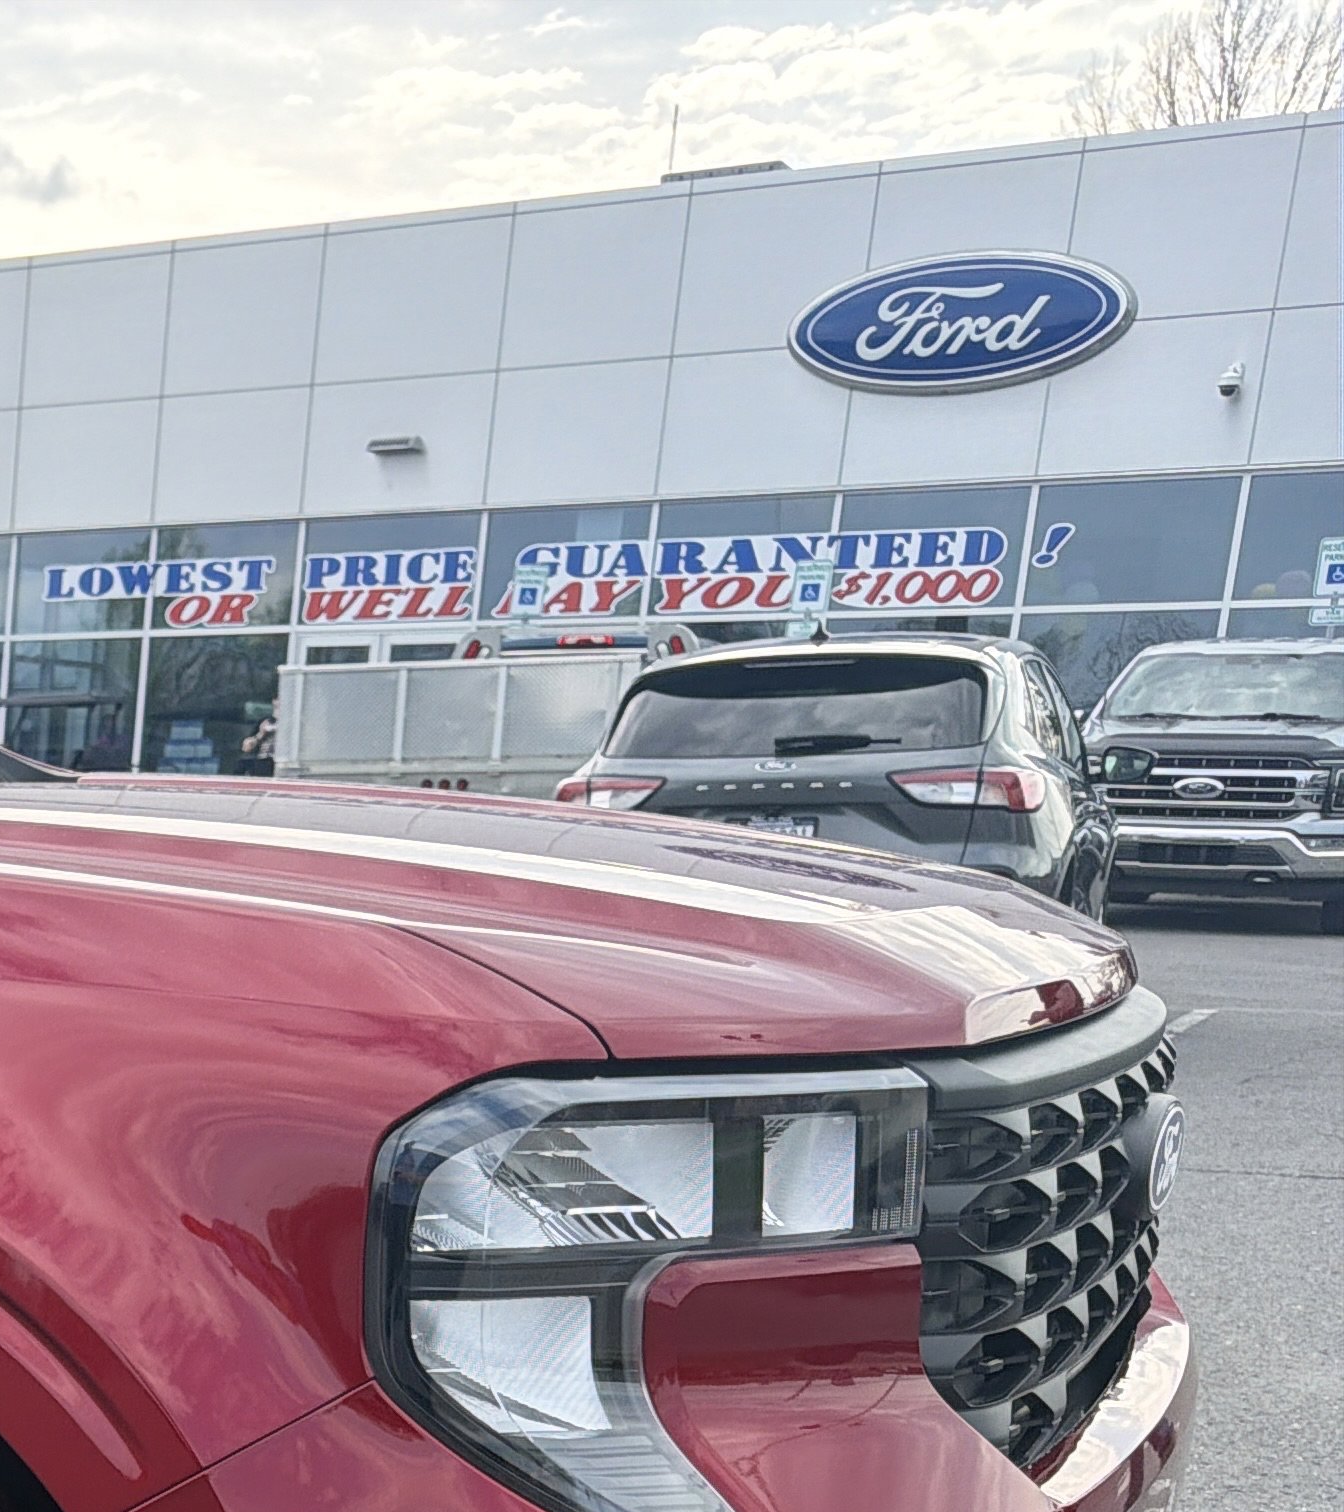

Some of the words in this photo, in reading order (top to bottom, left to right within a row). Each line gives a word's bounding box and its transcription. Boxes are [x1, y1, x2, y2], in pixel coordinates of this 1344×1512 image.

[855, 282, 1052, 361] Ford
[45, 559, 273, 599] LOWEST
[306, 550, 476, 589] PRICE
[519, 529, 1006, 578] GUARANTEED
[167, 594, 255, 625] OR
[495, 579, 641, 615] AY
[832, 568, 1001, 606] $1,000
